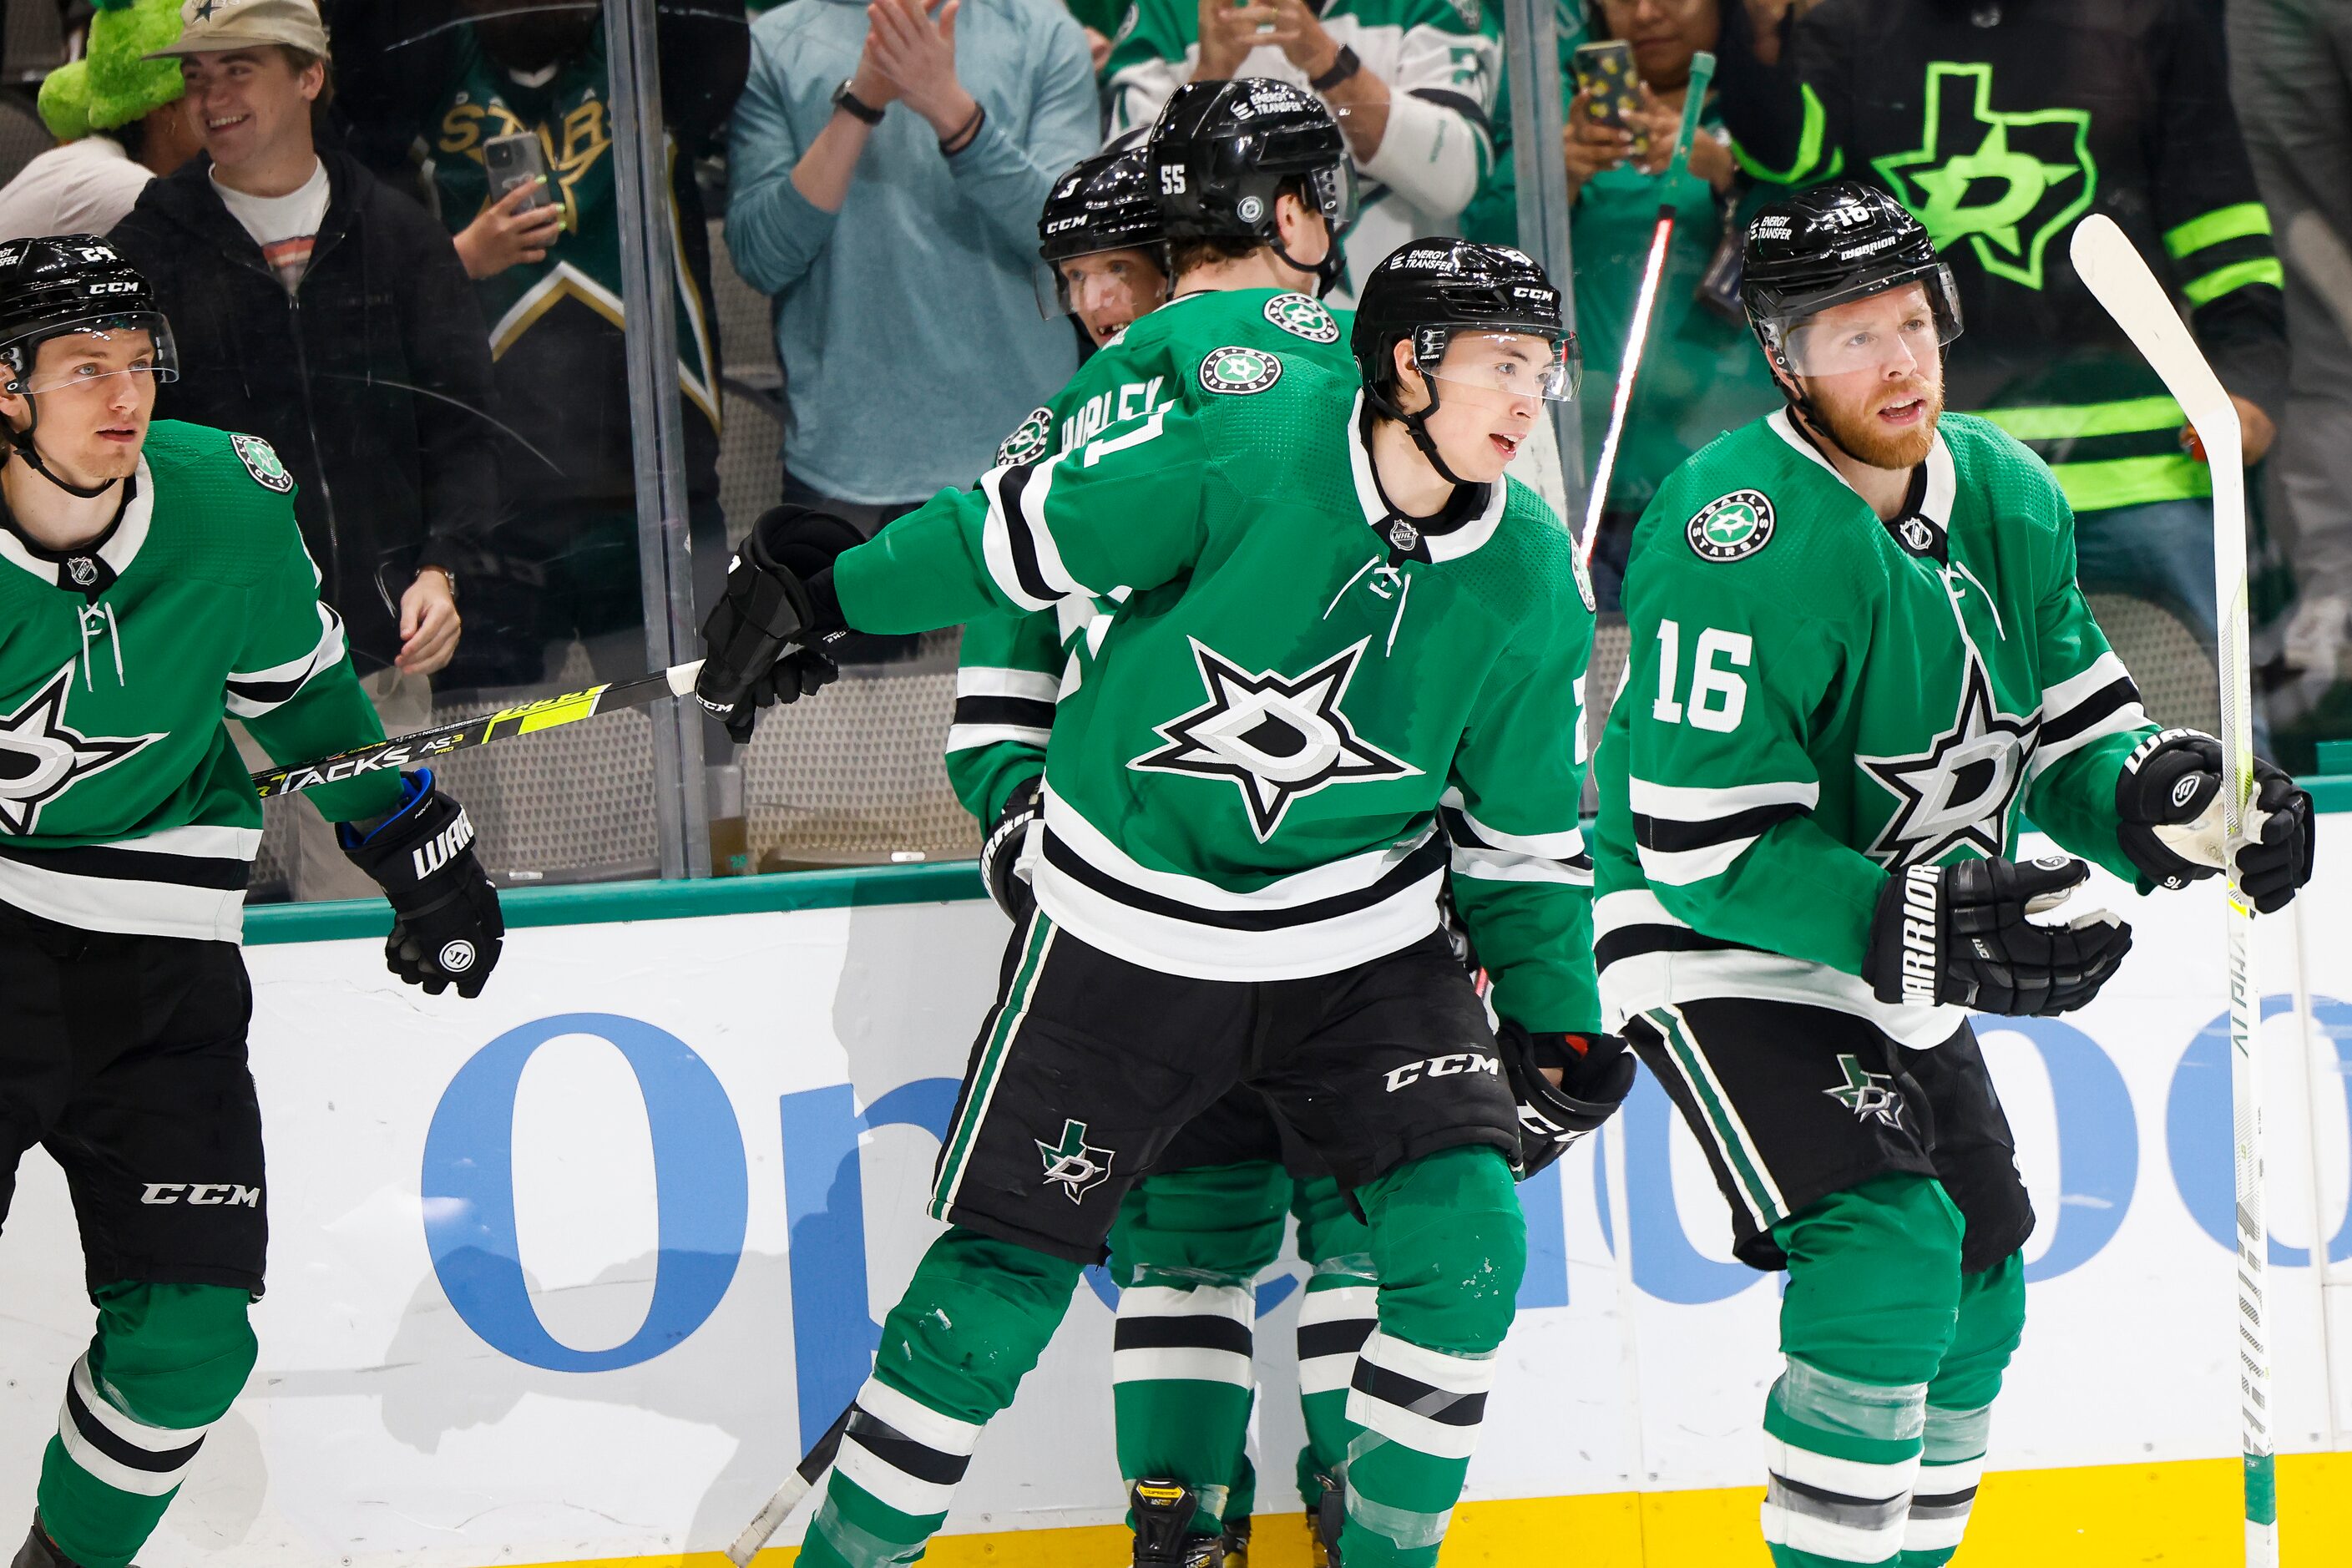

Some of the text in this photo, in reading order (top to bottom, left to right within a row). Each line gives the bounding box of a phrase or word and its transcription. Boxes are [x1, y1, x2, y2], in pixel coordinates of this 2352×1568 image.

[1058, 178, 1081, 199] 3
[1161, 164, 1186, 195] 55
[1047, 214, 1088, 235] CCM
[1761, 215, 1790, 228] ENERGY
[1758, 227, 1793, 240] TRANSFER
[1408, 250, 1449, 260] ENERGY
[1841, 235, 1897, 260] WARRIOR
[1404, 259, 1454, 272] TRANSFER
[89, 281, 139, 294] CCM
[1513, 286, 1553, 301] CCM
[1705, 494, 1769, 529] DALLAS
[1394, 532, 1412, 540] NHL
[1692, 527, 1752, 556] STARS
[1652, 619, 1753, 733] 16
[434, 746, 454, 755] PRO
[271, 746, 412, 795] TACKS
[1383, 1053, 1500, 1093] CCM
[140, 1182, 260, 1208] CCM
